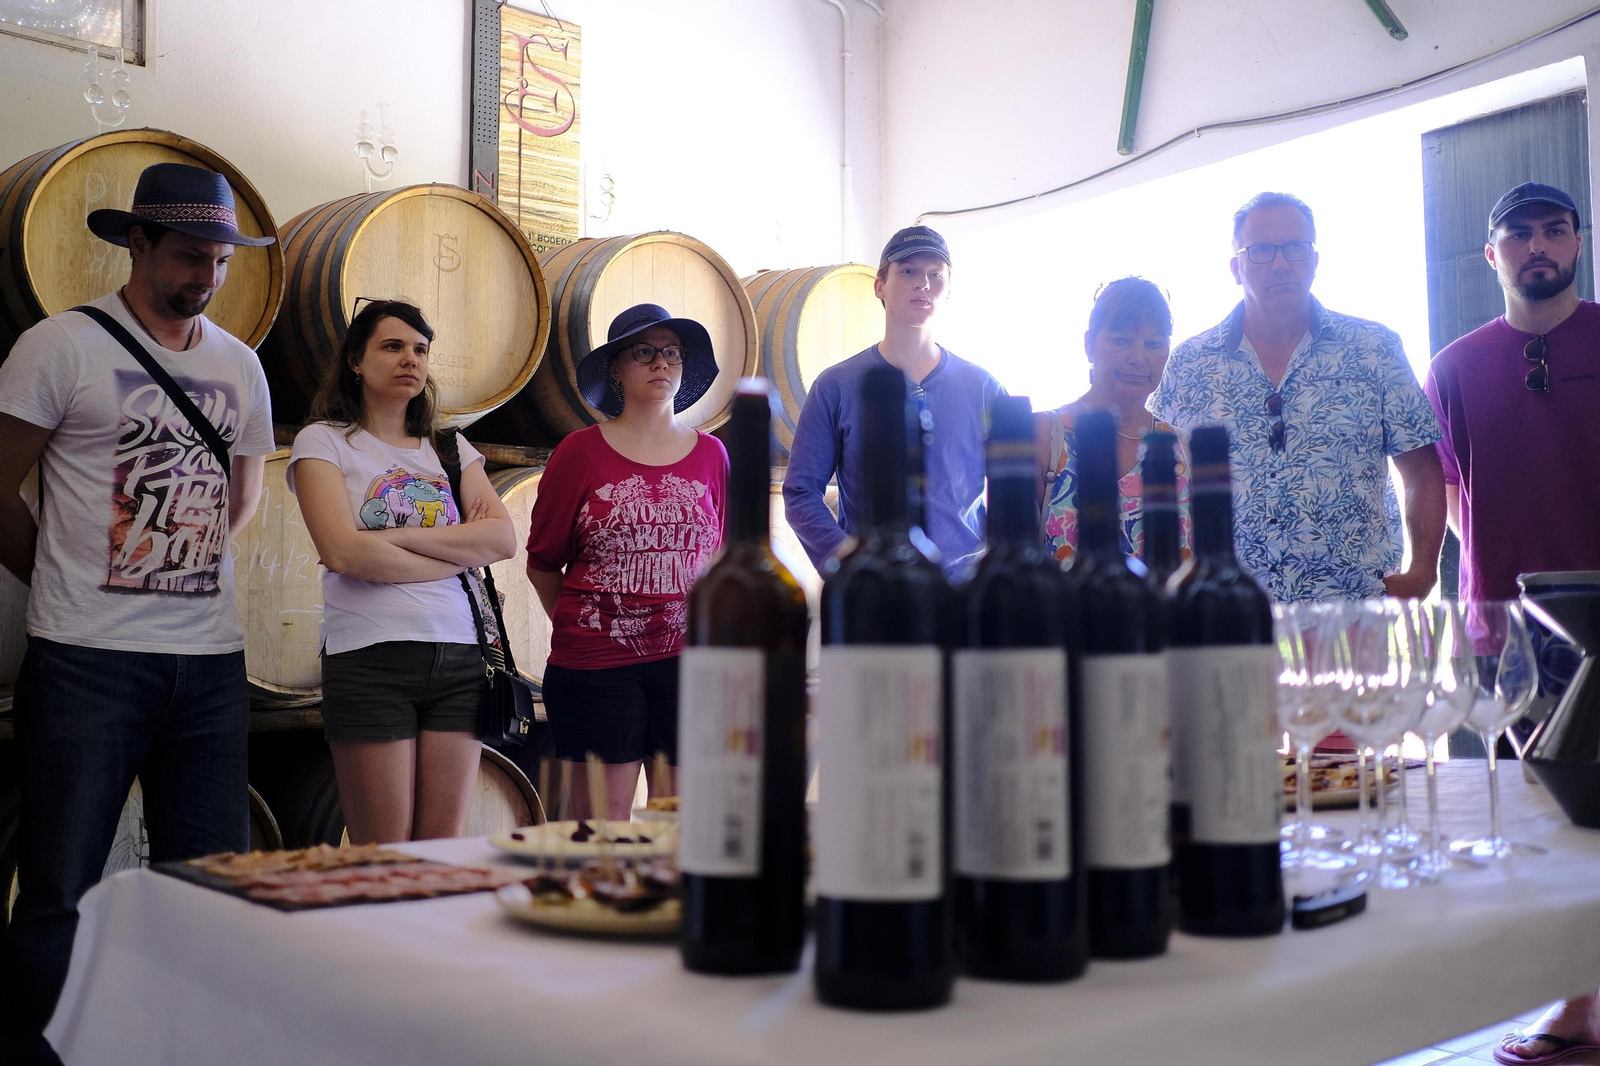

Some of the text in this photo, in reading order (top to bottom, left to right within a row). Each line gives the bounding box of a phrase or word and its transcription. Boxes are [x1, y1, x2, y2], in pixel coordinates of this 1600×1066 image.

[428, 351, 474, 370] OSGES
[619, 502, 697, 525] WORRY
[618, 525, 702, 552] ABOUT
